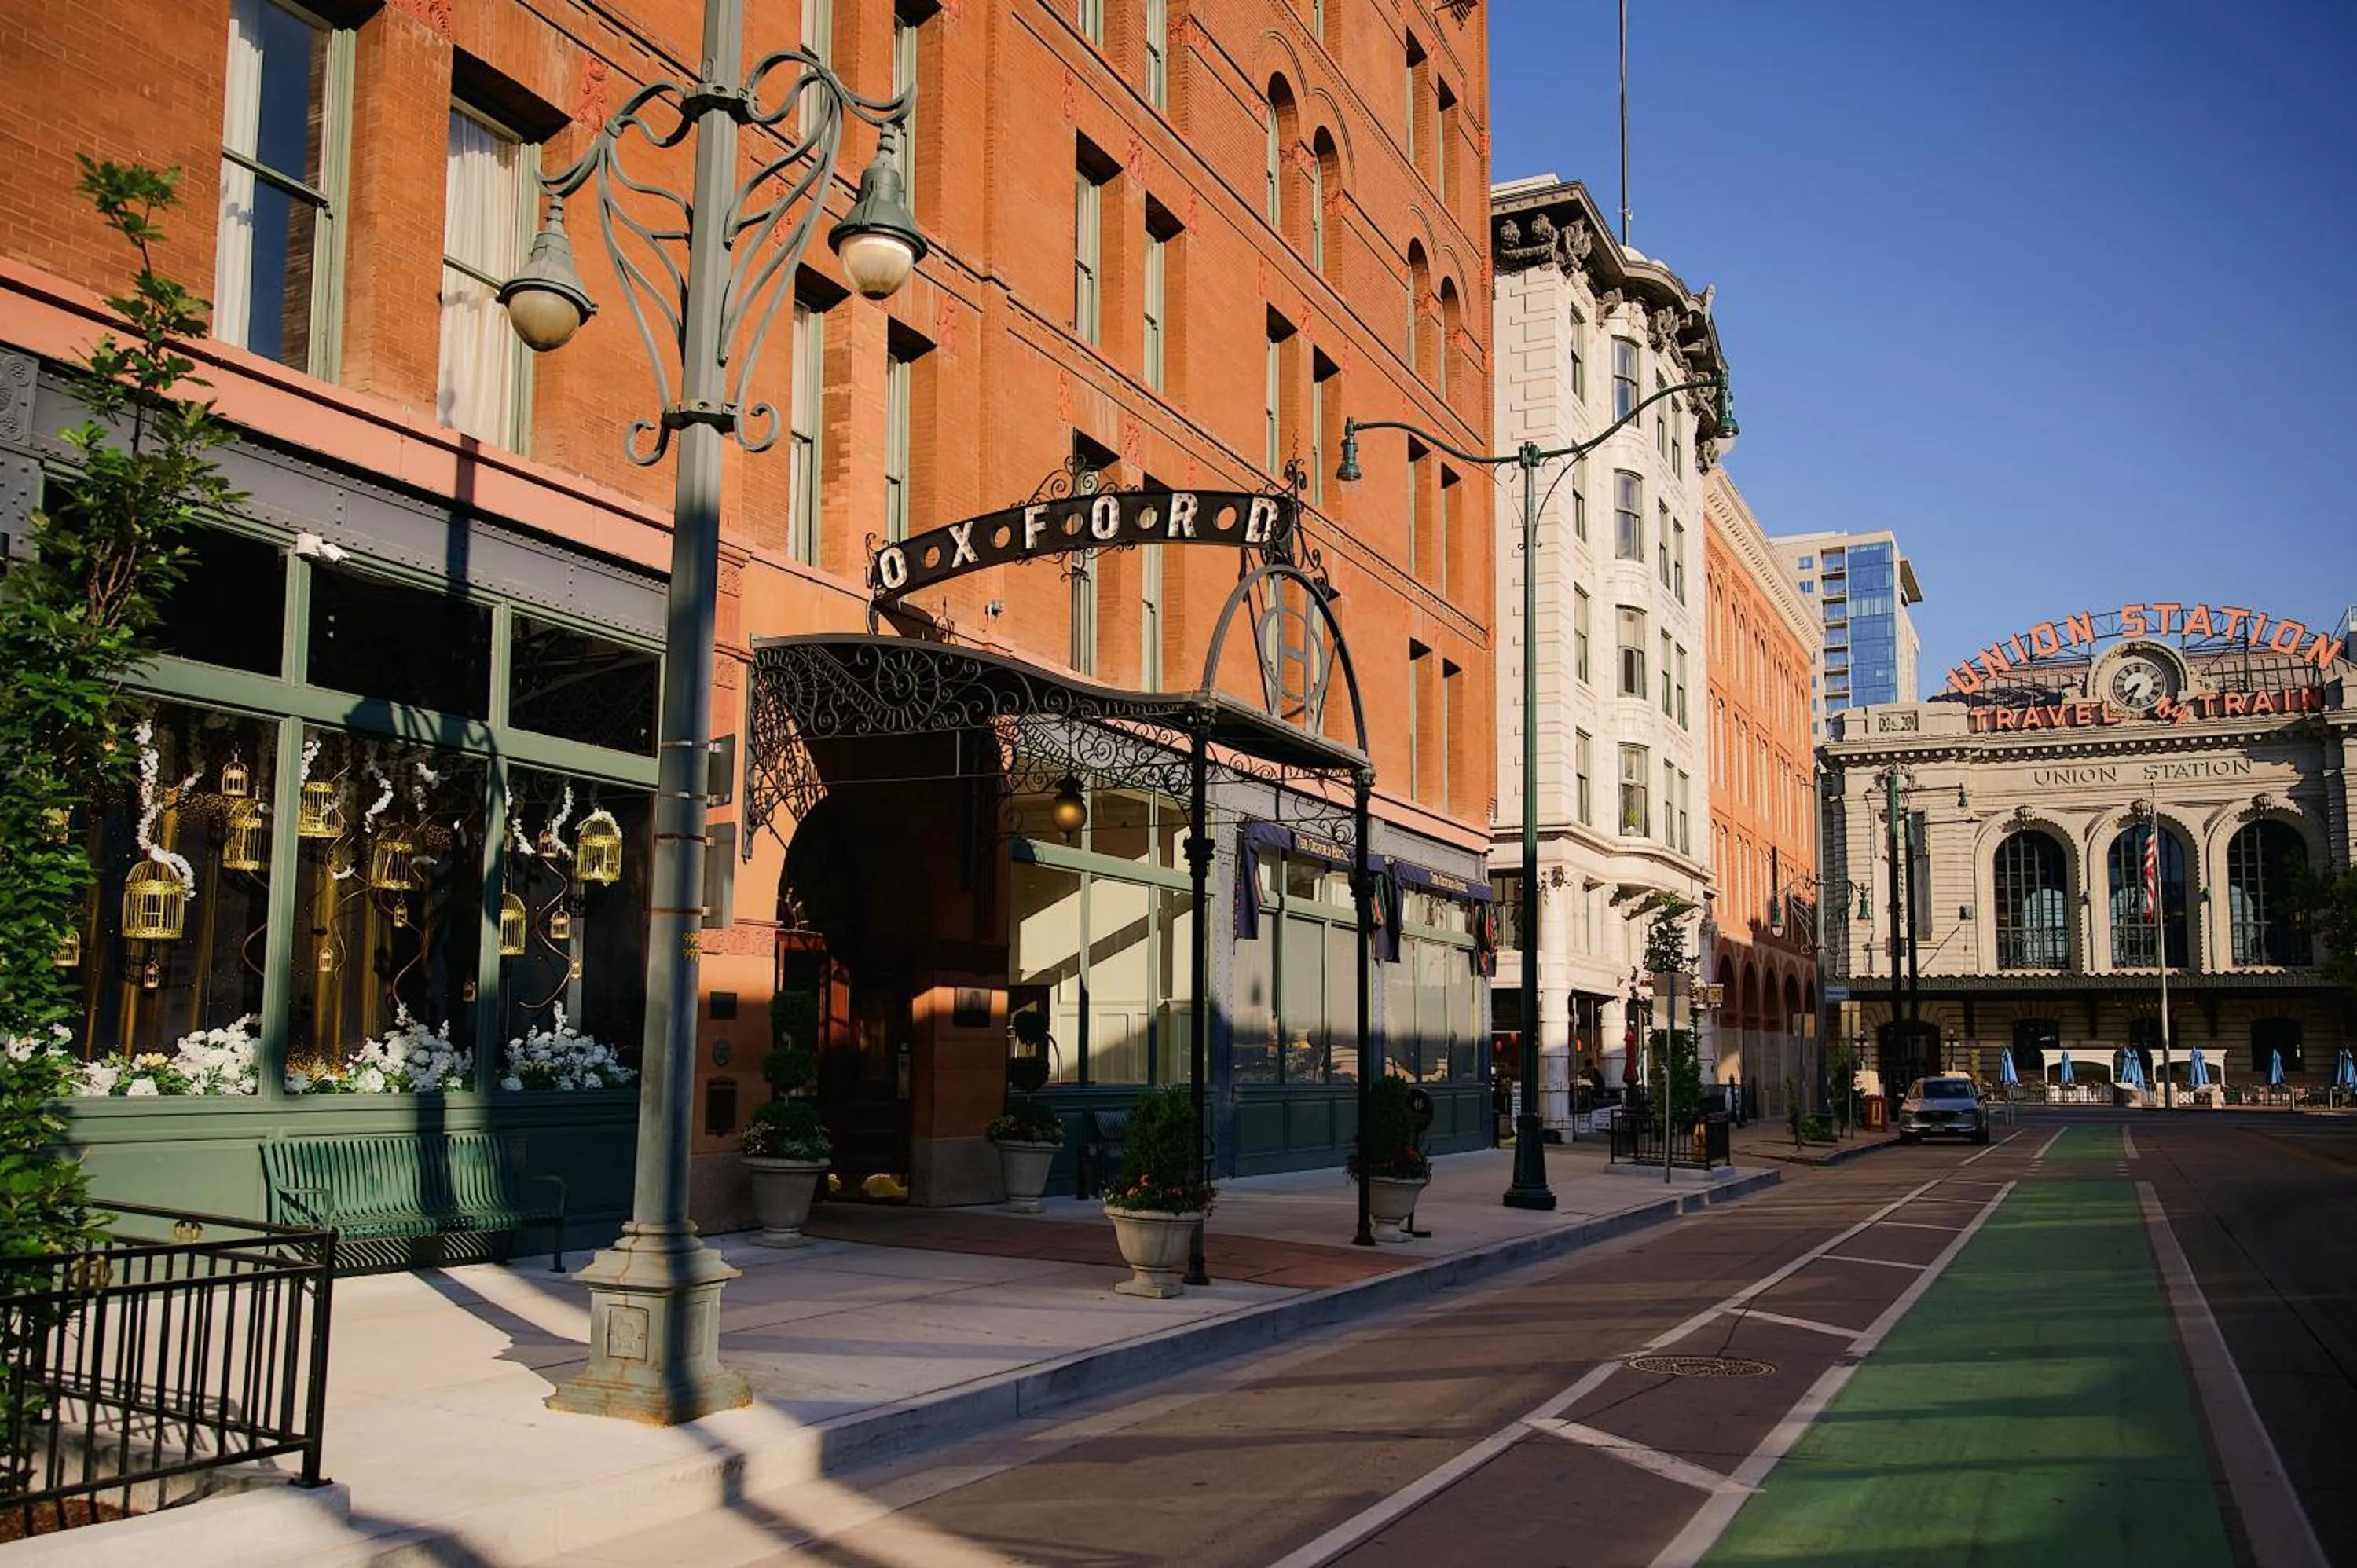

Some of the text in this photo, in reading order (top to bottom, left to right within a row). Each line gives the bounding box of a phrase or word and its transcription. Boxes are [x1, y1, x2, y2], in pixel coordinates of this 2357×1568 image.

[878, 492, 1279, 589] OXFORD
[1947, 610, 2095, 694] UNION
[2121, 603, 2344, 670] STATION
[1970, 686, 2324, 731] TRAVEL by TRAIN
[2033, 760, 2252, 786] UNION STATION
